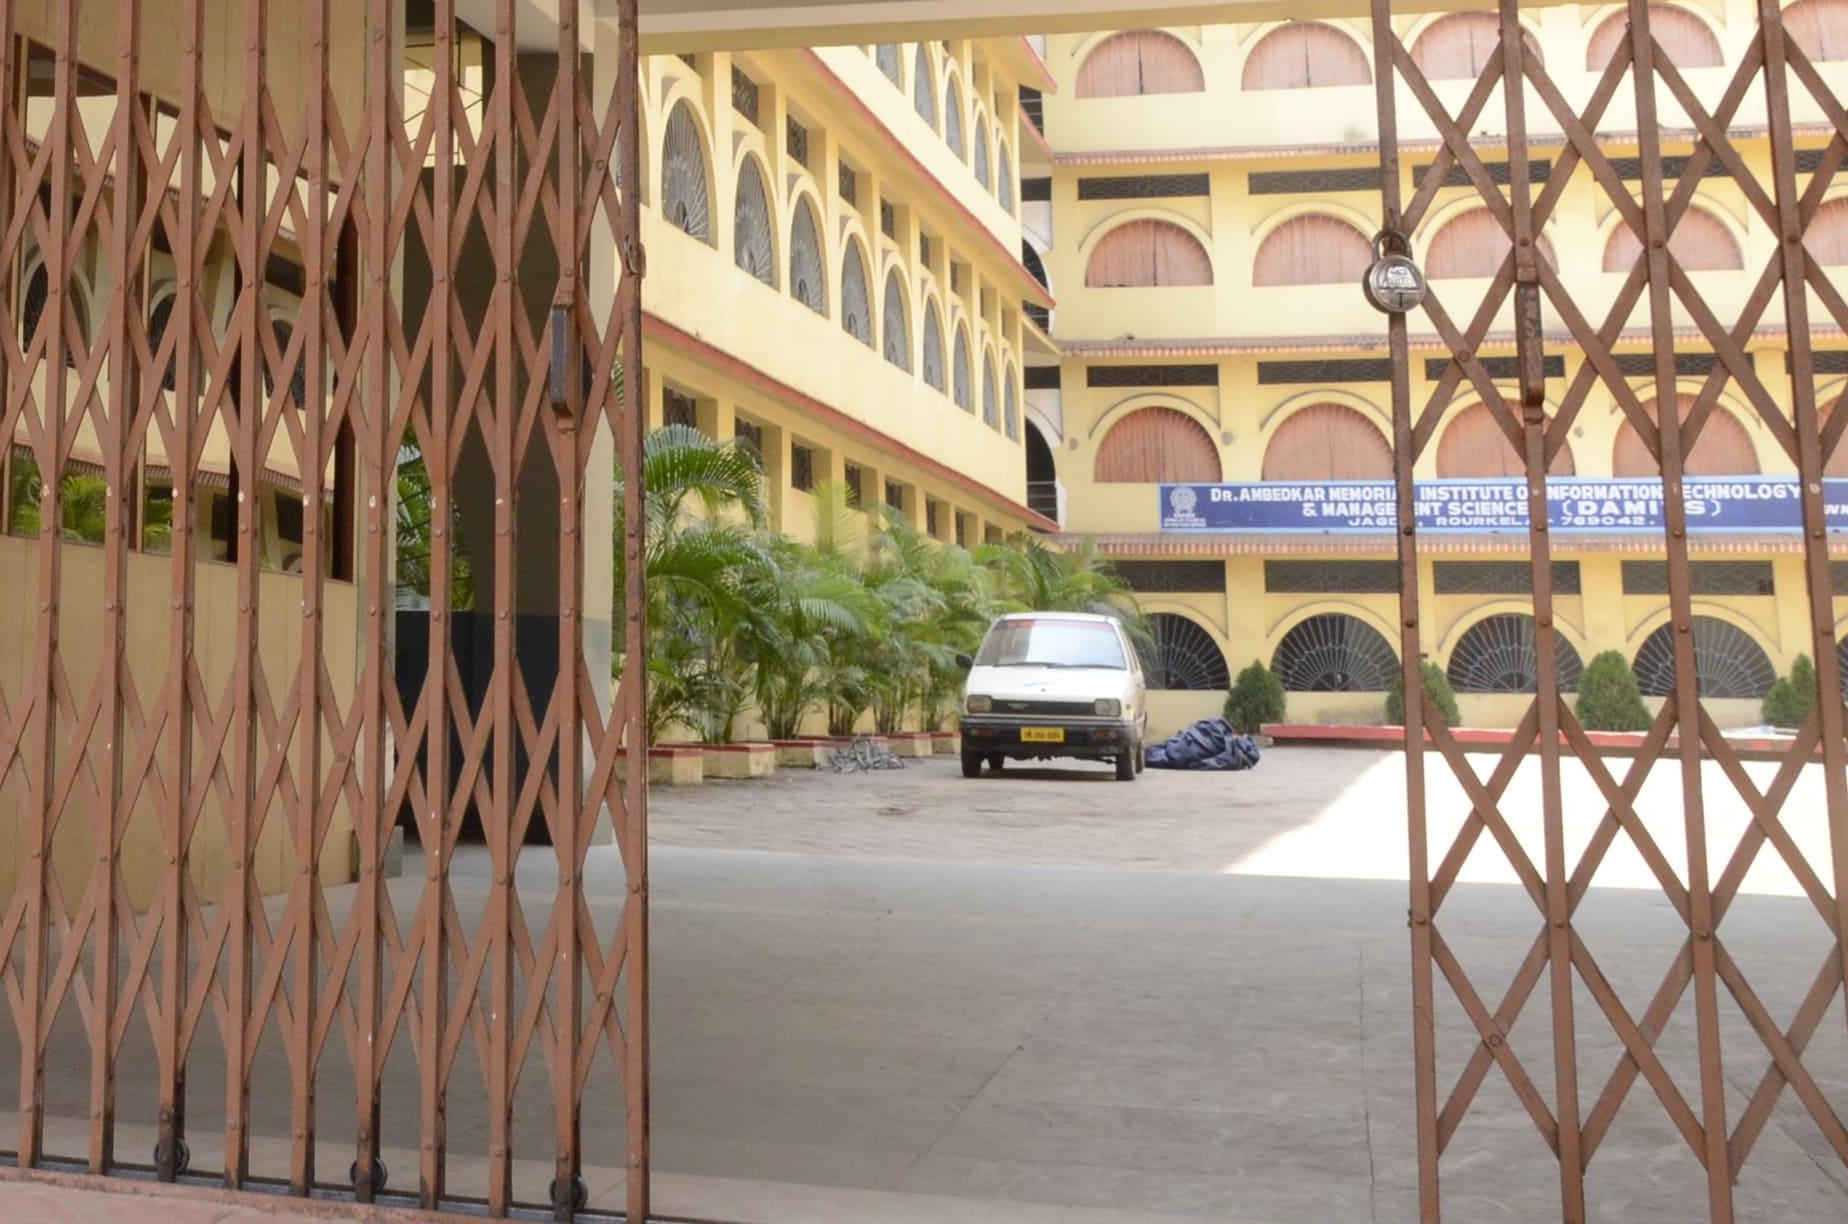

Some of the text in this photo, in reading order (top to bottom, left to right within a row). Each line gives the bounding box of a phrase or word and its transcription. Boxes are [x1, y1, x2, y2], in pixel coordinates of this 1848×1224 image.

[1328, 485, 1398, 502] MEMORI
[1419, 485, 1513, 501] INSTITUTE
[1546, 484, 1664, 501] NFORMATION
[1682, 483, 1801, 500] ECHNOLOGY
[1302, 502, 1317, 517] &
[1321, 501, 1443, 517] MANAGENT
[1562, 499, 1721, 517] (DAMIS)
[1348, 517, 1424, 527] JAGD,
